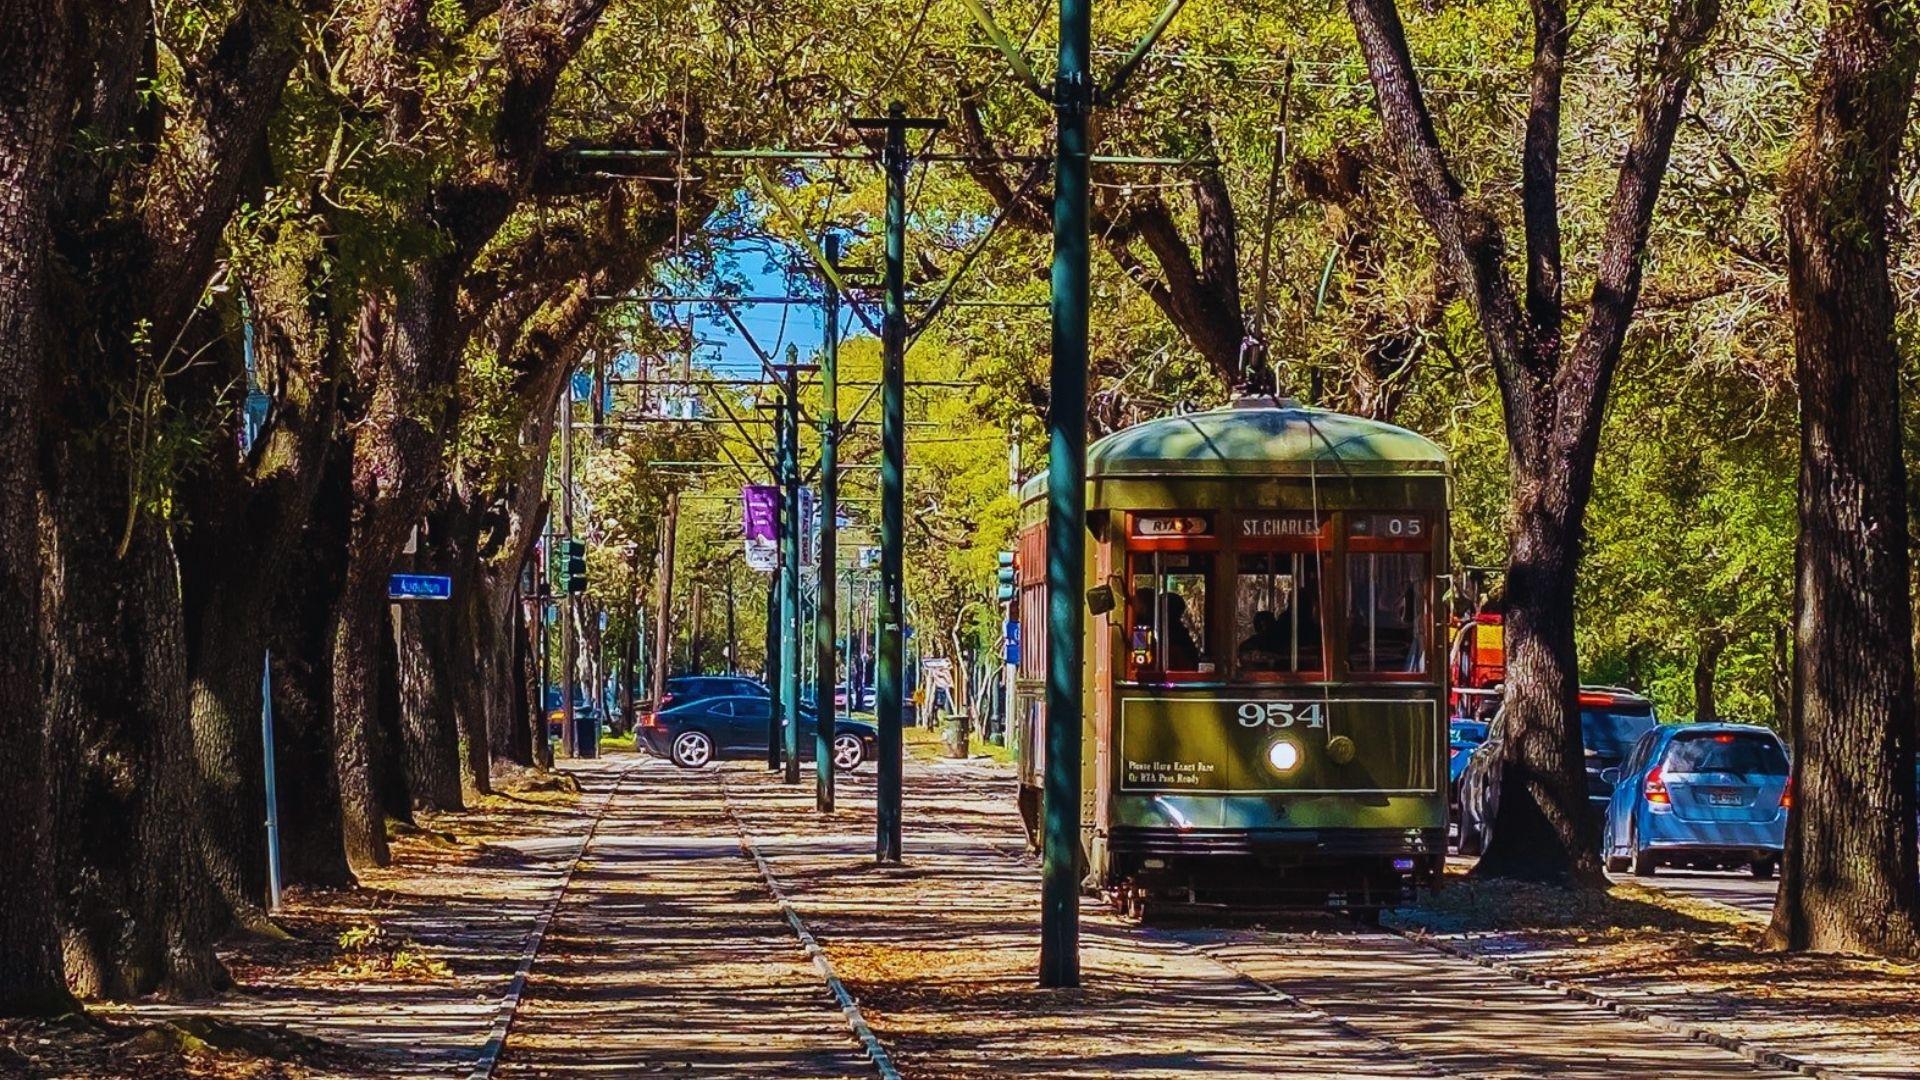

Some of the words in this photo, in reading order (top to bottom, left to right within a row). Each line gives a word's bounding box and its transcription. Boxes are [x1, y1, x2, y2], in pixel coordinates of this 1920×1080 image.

[1243, 519, 1260, 535] ST.
[1263, 519, 1321, 535] CHARLES
[1237, 702, 1324, 728] 954
[1128, 760, 1151, 771] Please
[1153, 761, 1171, 771] Have
[1173, 761, 1196, 771] Exact
[1197, 761, 1214, 772] Fare
[1128, 772, 1138, 783] Or
[1140, 773, 1157, 783] RTA
[1158, 773, 1175, 783] Pass
[1176, 772, 1200, 785] Ready
